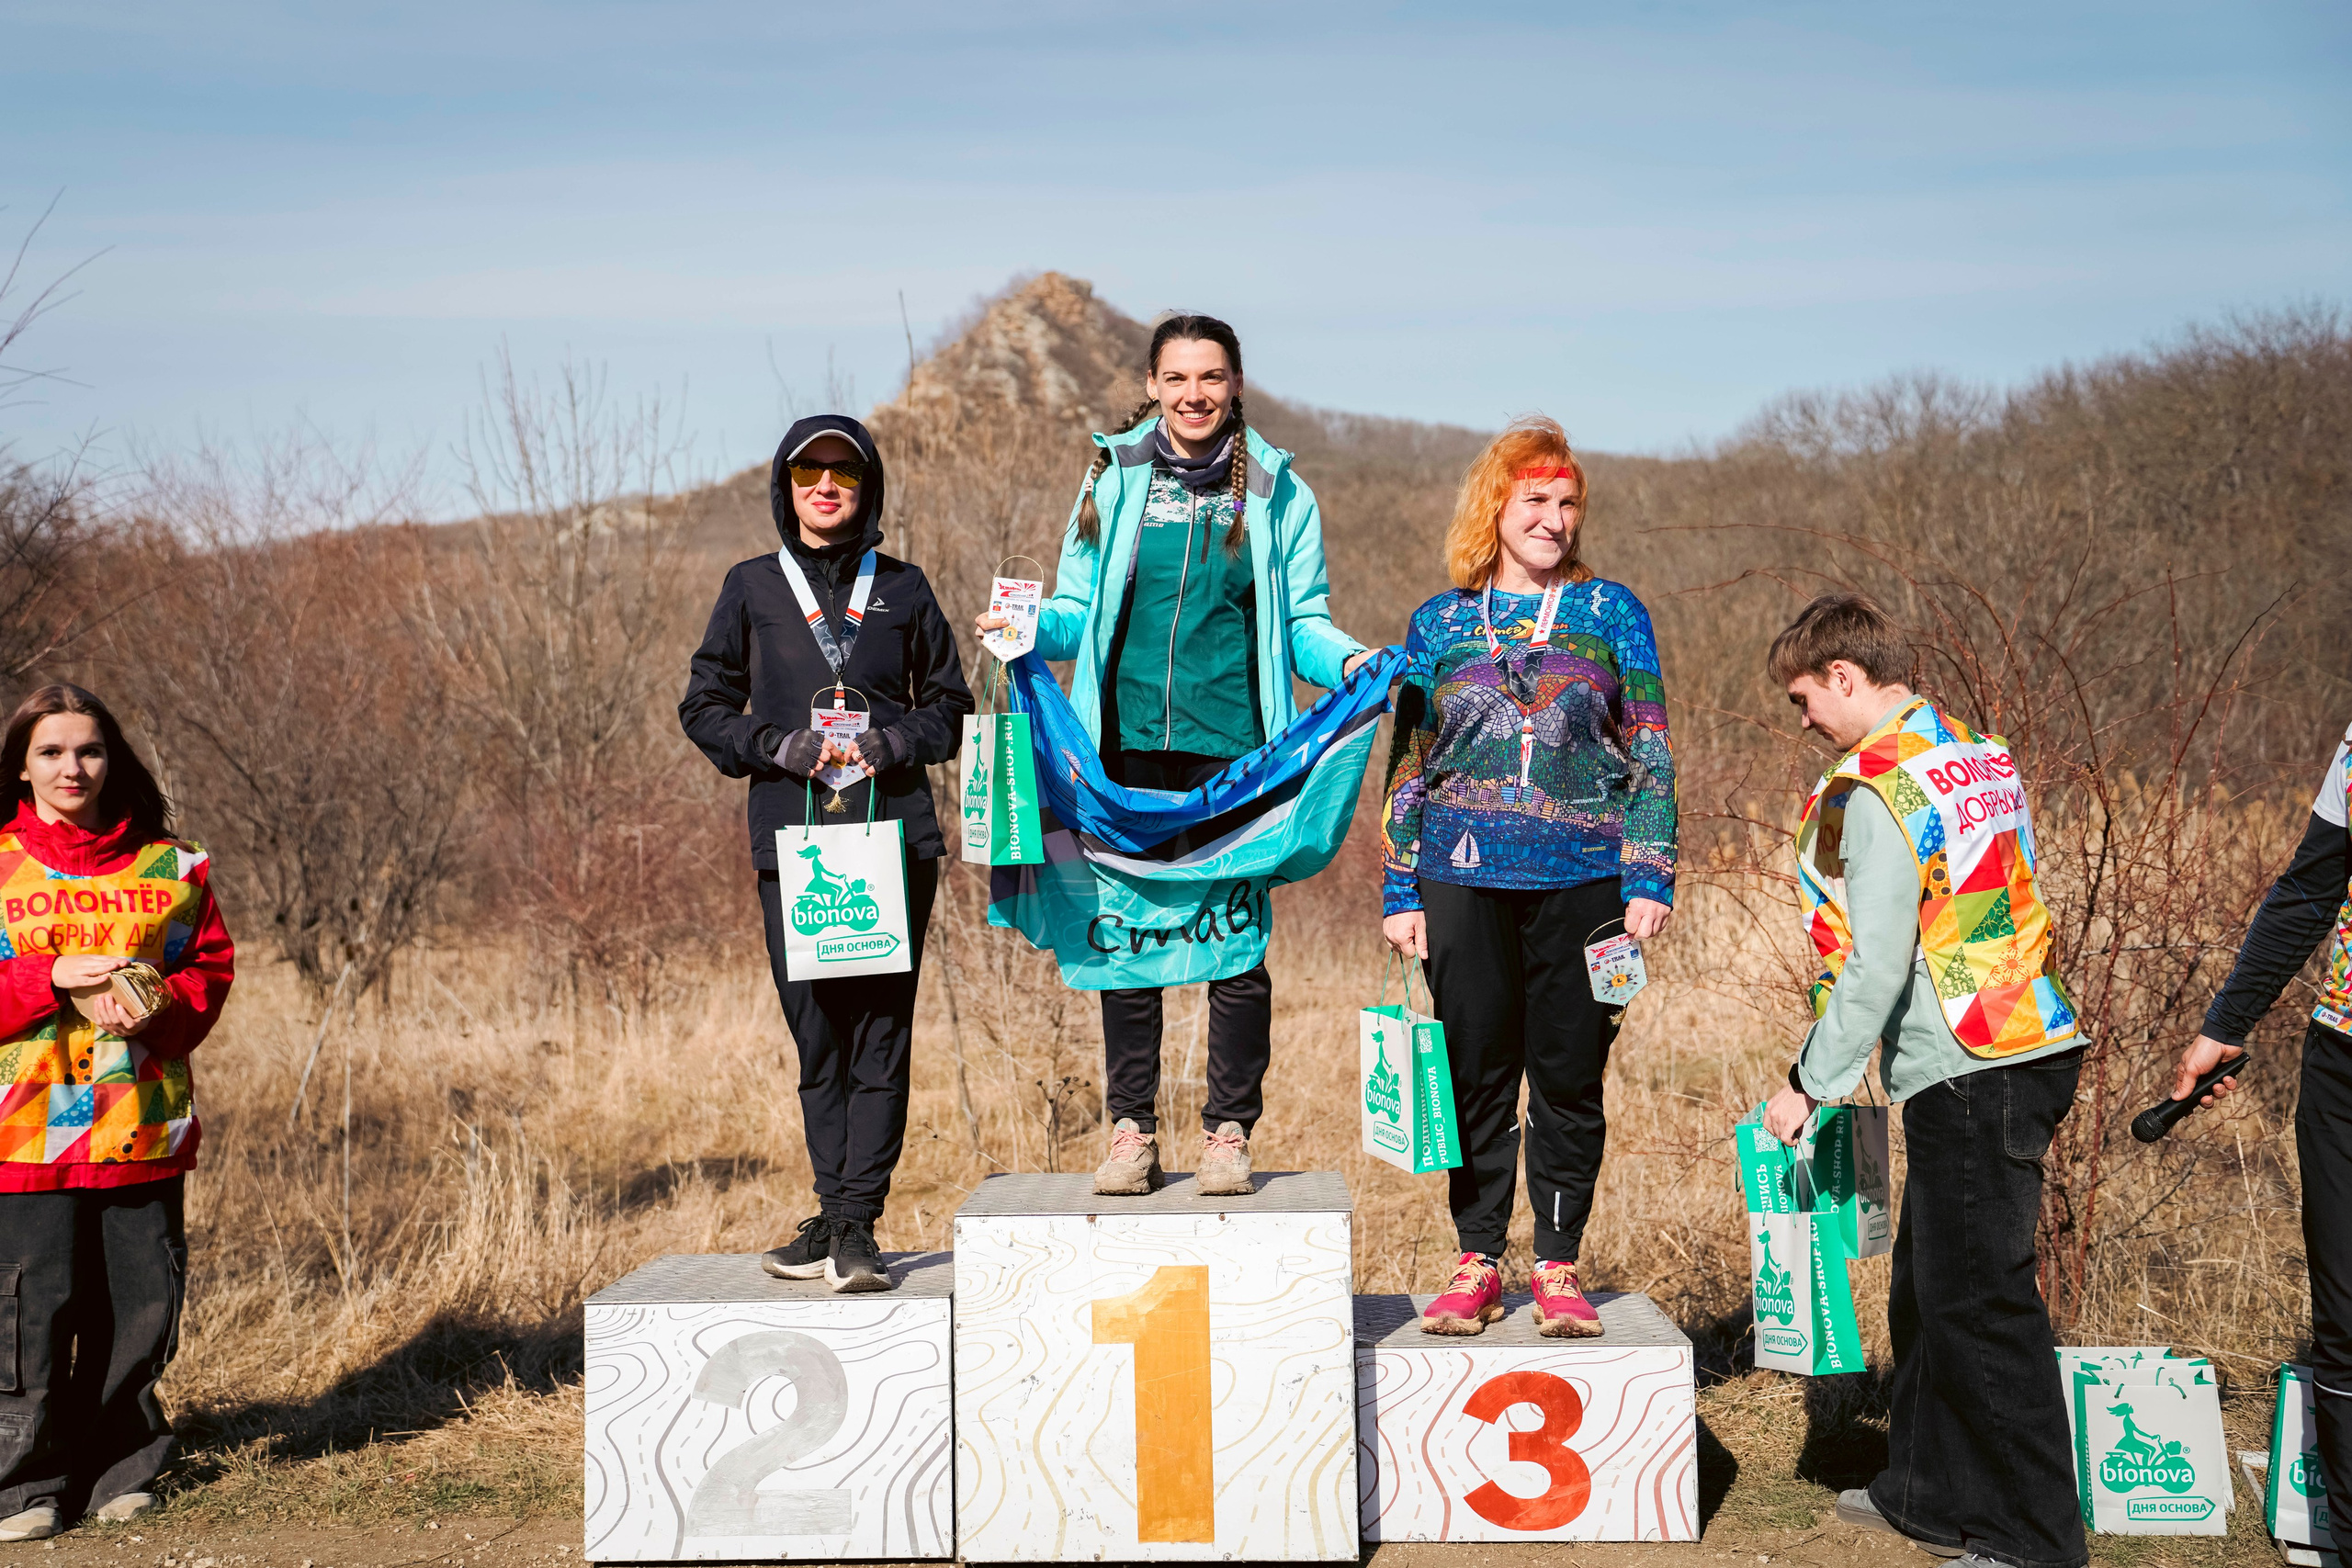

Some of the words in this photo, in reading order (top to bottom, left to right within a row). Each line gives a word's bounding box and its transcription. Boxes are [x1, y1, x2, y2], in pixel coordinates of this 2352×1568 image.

[1541, 594, 1555, 628] ЛЕРМОНТОВ
[965, 789, 988, 809] bionova
[1005, 722, 1022, 860] BIONOVA-SHOP.RU
[6, 884, 173, 923] ВОЛОНТЁР
[794, 904, 878, 925] bionova
[17, 922, 116, 956] ДОБРЫХ
[125, 922, 164, 952] ДЕЛ
[821, 943, 844, 955] ДНЯ
[847, 939, 892, 952] ОСНОВА
[1367, 1084, 1400, 1114] bionova
[1428, 1066, 1449, 1164] PUBLIC_BIONOVA
[1375, 1126, 1385, 1138] ДНЯ
[1385, 1129, 1406, 1145] ОСНОВА
[1860, 1184, 1884, 1203] bionova
[1756, 1289, 1794, 1314] bionova
[1765, 1334, 1776, 1345] ДНЯ
[1777, 1336, 1803, 1348] ОСНОВА
[1091, 1265, 1214, 1543] 1
[688, 1331, 852, 1537] 2
[1463, 1371, 1591, 1532] 3
[2103, 1461, 2194, 1483] bionova
[2132, 1504, 2156, 1514] ДНЯ
[2160, 1504, 2207, 1513] ОСНОВА
